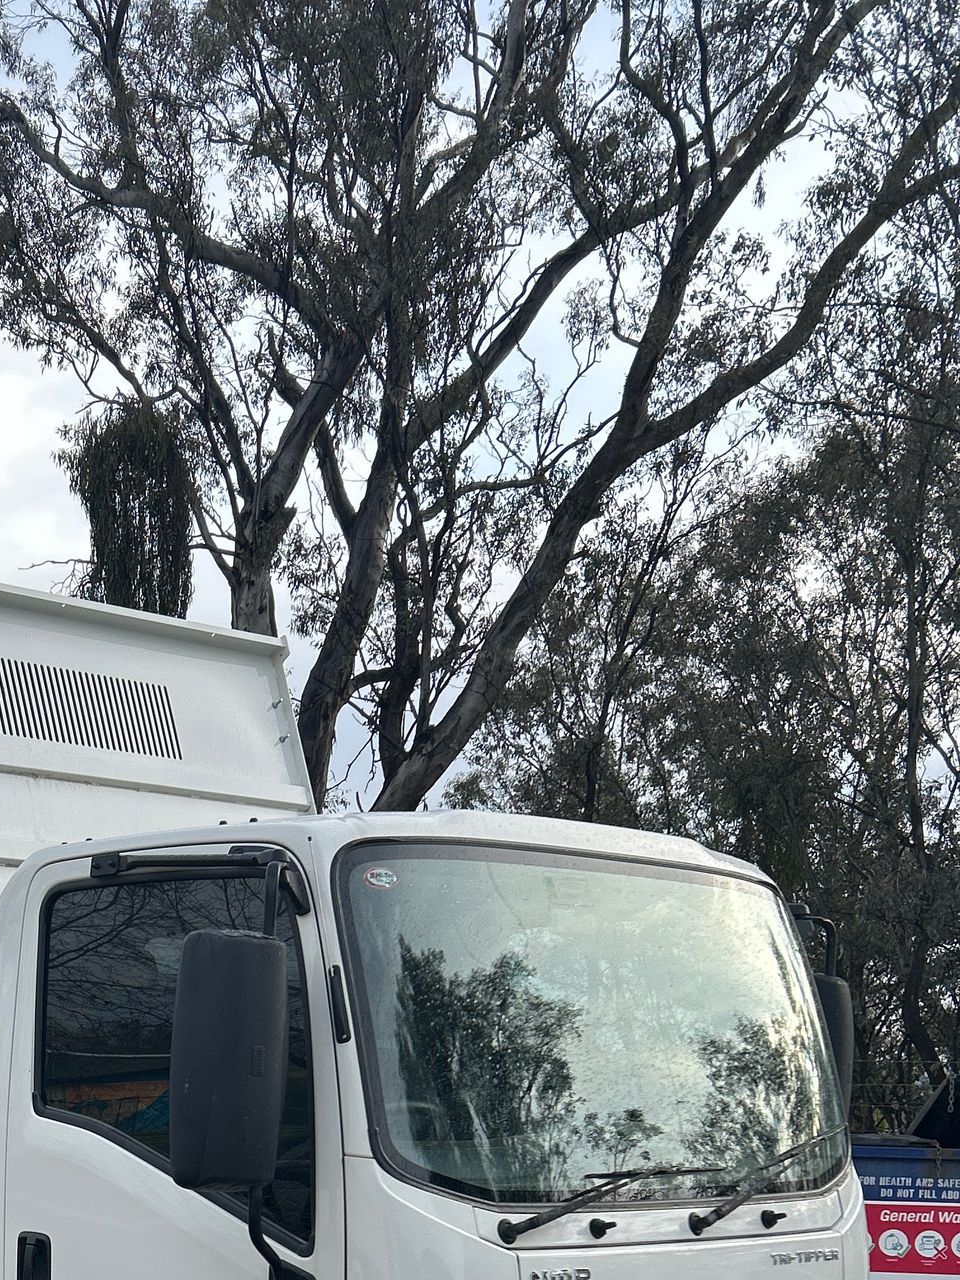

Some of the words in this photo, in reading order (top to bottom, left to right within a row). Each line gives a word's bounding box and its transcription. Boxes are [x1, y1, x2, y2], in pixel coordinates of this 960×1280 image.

[859, 1176, 876, 1186] FOR
[880, 1177, 912, 1187] HEALTH
[915, 1178, 934, 1187] AND
[880, 1188, 893, 1197] DO
[897, 1189, 915, 1198] NOT
[919, 1190, 937, 1199] FILL
[880, 1210, 934, 1223] General
[770, 1249, 839, 1266] TRI-TIPPER
